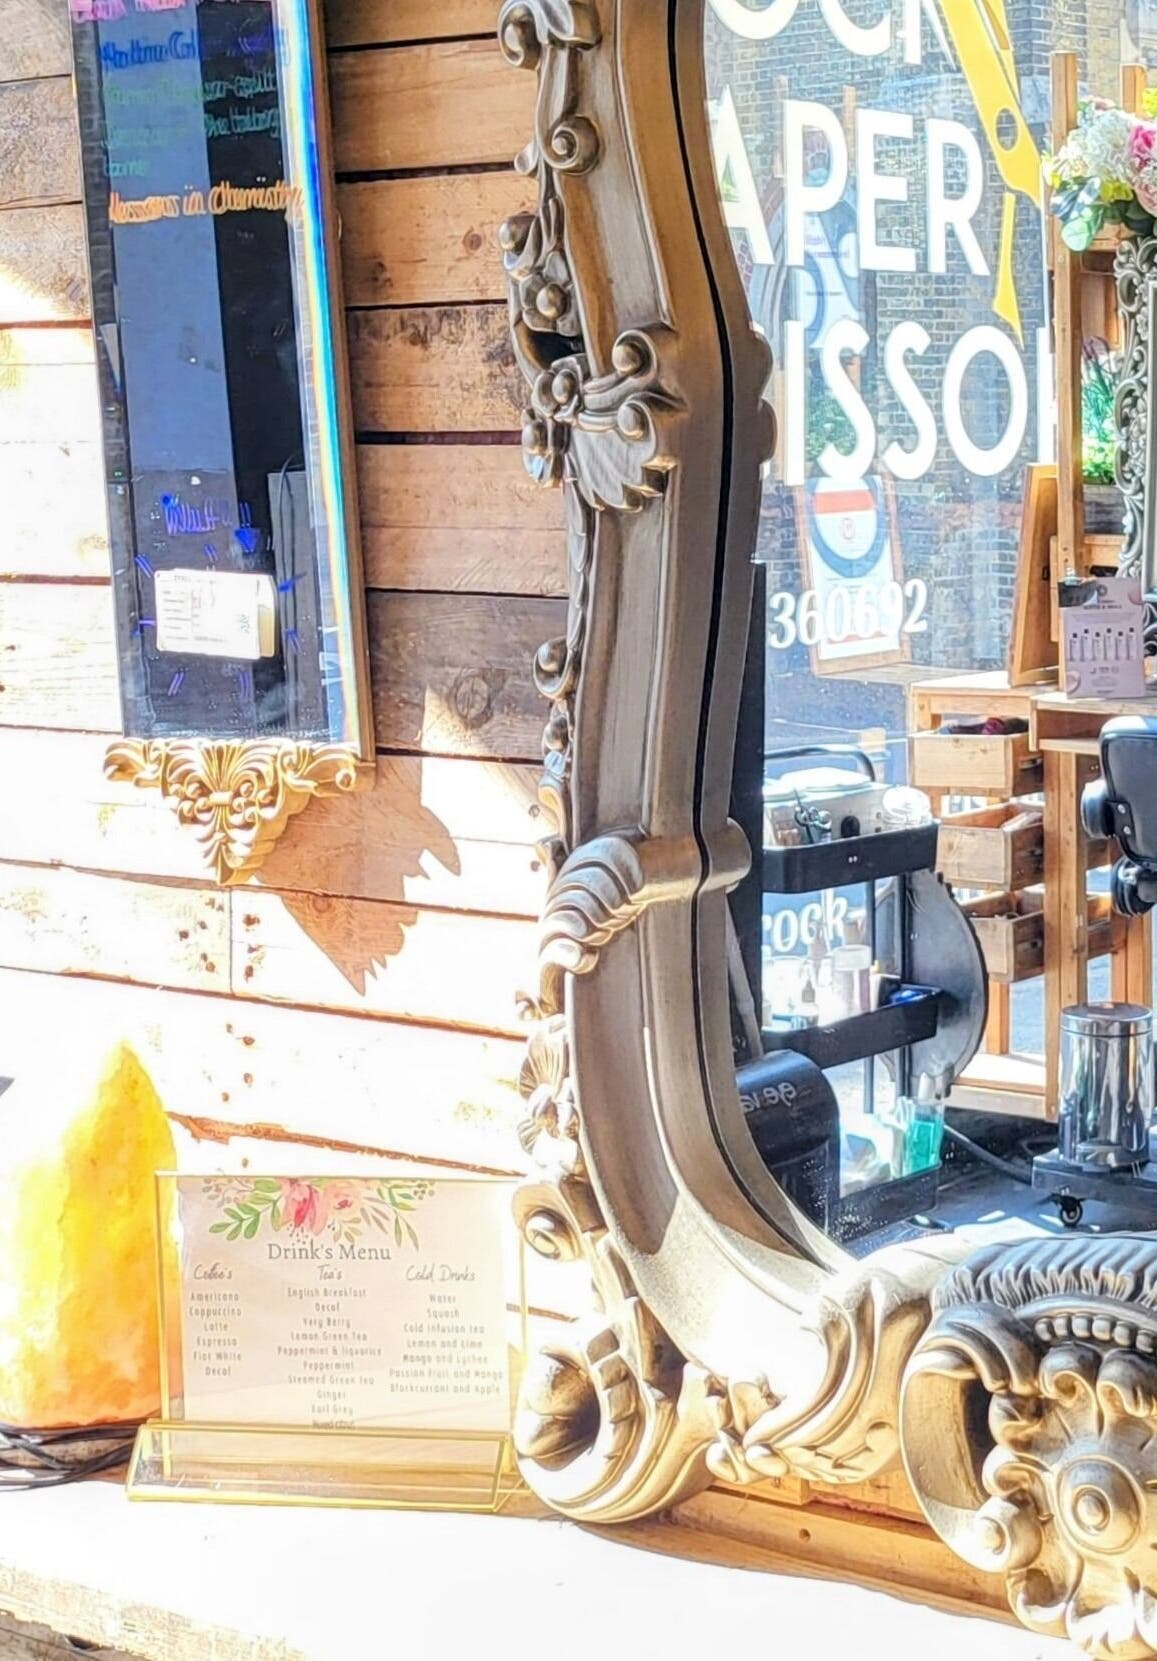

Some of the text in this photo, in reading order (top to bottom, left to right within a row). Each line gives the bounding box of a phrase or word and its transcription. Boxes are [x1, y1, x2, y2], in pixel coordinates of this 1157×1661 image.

[770, 578, 928, 650] 360692
[268, 1242, 391, 1260] Drink's Menu
[317, 1264, 342, 1280] Tea's
[406, 1264, 435, 1282] Cold
[191, 1293, 239, 1302] Americano
[288, 1287, 365, 1299] English Breakfast
[429, 1294, 456, 1304] Water
[315, 1302, 339, 1312] Decaf
[189, 1306, 241, 1319] Cappuccino
[427, 1308, 459, 1319] Squash
[204, 1322, 228, 1332] Latte
[303, 1317, 350, 1329] Very Berry
[404, 1322, 423, 1333] Cold
[291, 1332, 319, 1341] Lemon
[322, 1331, 348, 1341] Green
[197, 1336, 237, 1347] Espresso
[407, 1340, 437, 1348] Lemon
[193, 1351, 241, 1361] Flat White
[277, 1346, 328, 1356] Peppermint
[205, 1366, 231, 1376] Decaf
[303, 1361, 354, 1371] Peppermint
[329, 1375, 355, 1384] Green
